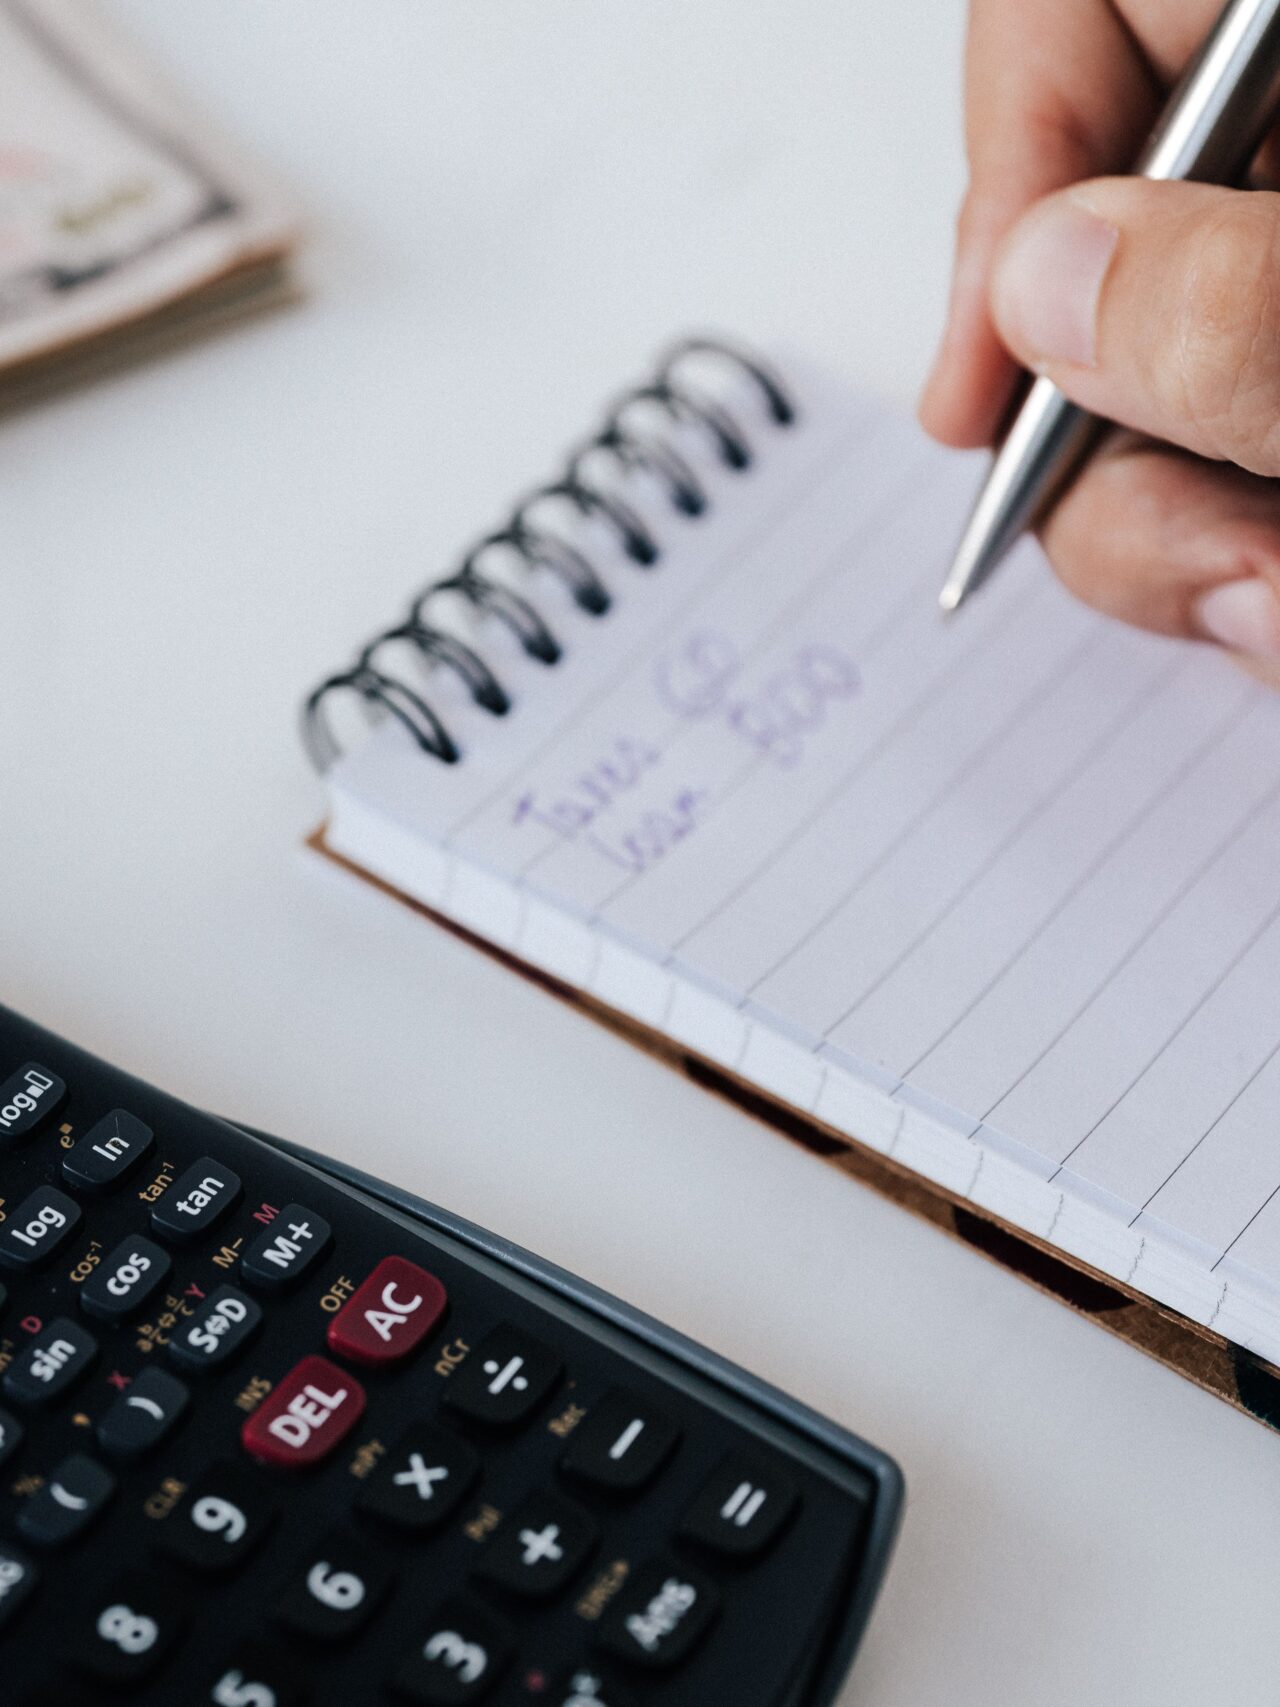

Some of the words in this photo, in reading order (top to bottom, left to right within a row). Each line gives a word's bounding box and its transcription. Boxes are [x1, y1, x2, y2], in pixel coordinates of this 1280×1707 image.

[92, 1135, 130, 1161] ln
[177, 1175, 225, 1217] tan
[253, 1203, 280, 1225] M
[11, 1204, 67, 1247] log
[263, 1220, 315, 1268] M+
[107, 1251, 152, 1296] cos
[320, 1274, 356, 1313] OFF
[21, 1316, 43, 1334] D
[364, 1281, 423, 1342] AC
[30, 1337, 77, 1383] sin
[434, 1337, 471, 1377] nCr
[268, 1383, 348, 1449] DEL
[191, 1496, 247, 1543] 9
[307, 1560, 366, 1611] 6
[96, 1604, 159, 1654] 8
[423, 1629, 489, 1684] 3
